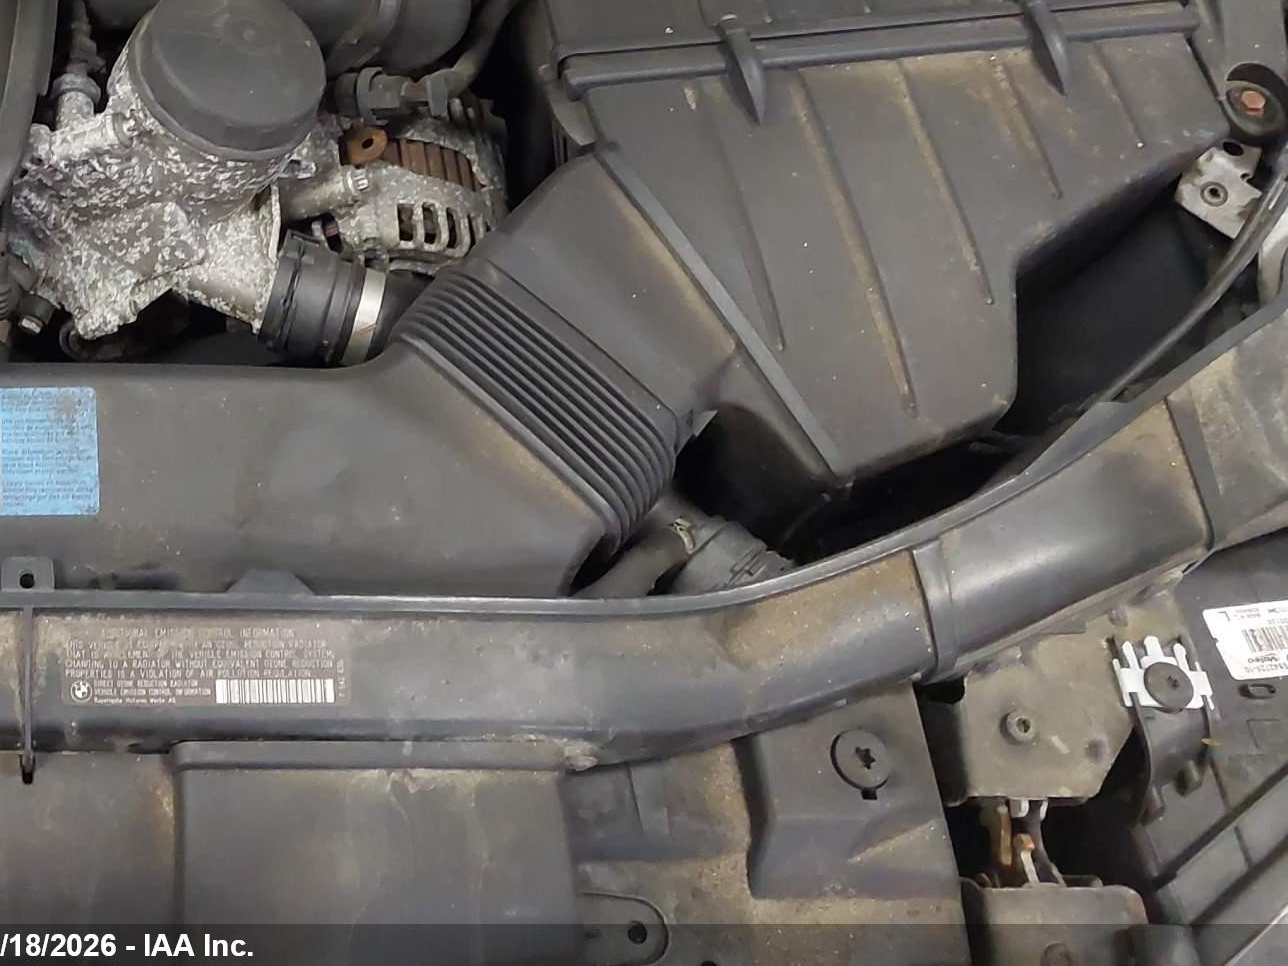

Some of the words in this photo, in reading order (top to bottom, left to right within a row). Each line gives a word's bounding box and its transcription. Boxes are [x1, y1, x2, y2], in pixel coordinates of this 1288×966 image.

[1247, 656, 1278, 664] Valeo
[140, 669, 182, 678] VIOLATION
[200, 669, 214, 679] AIR
